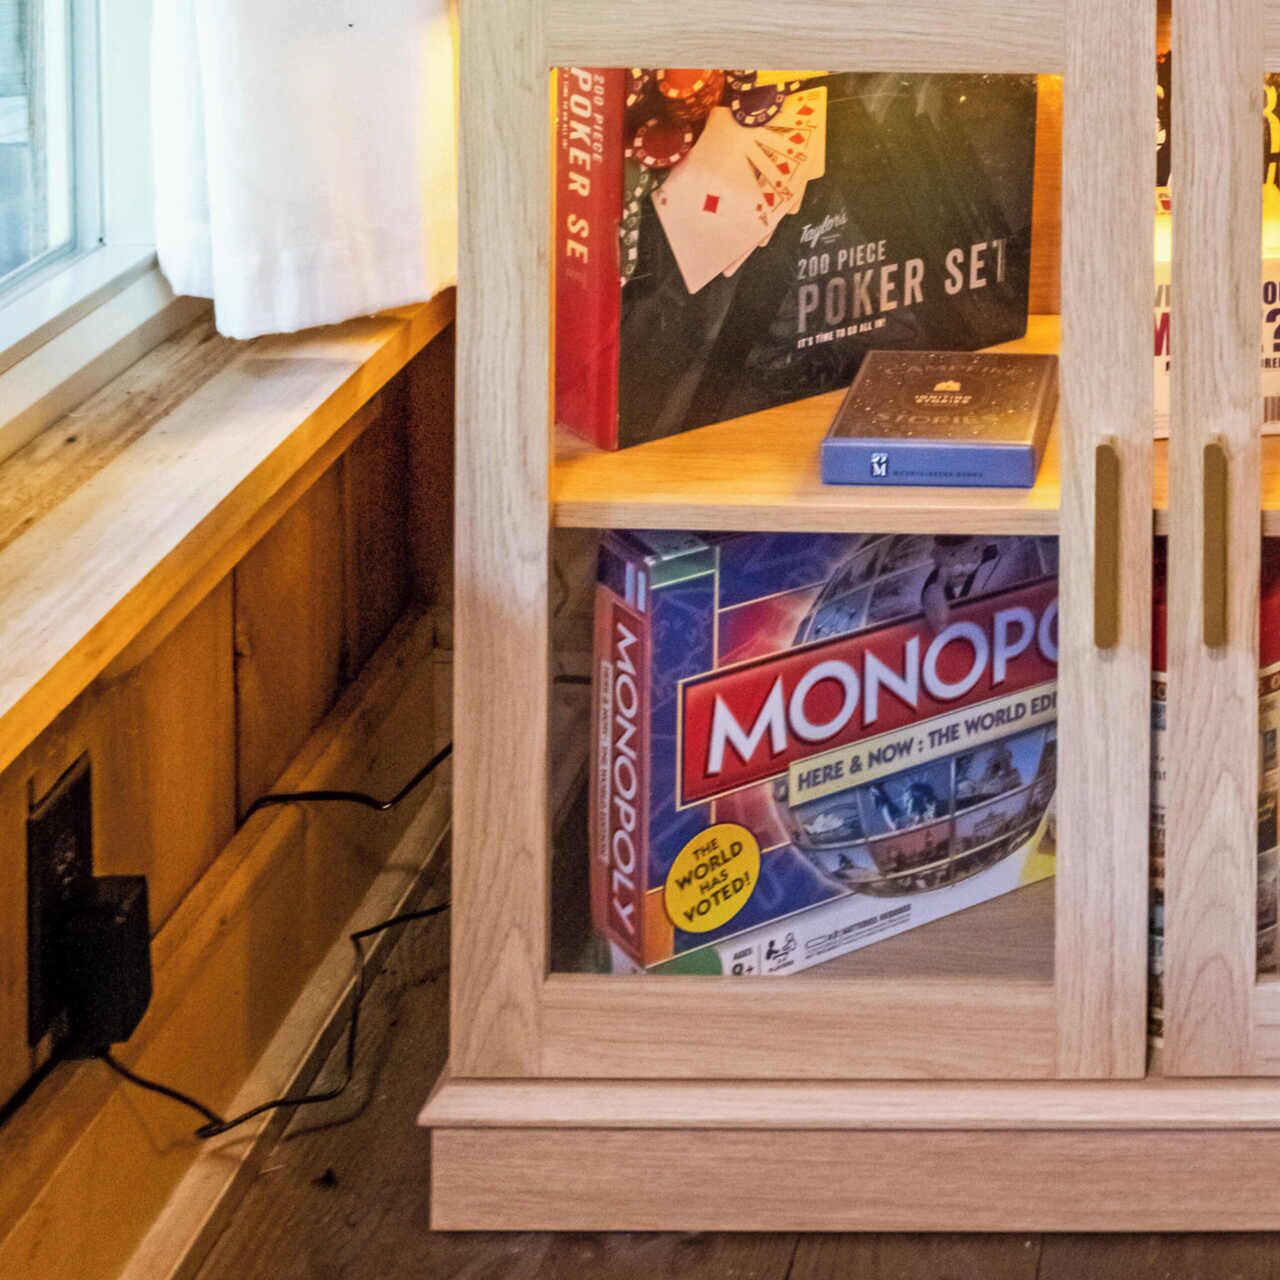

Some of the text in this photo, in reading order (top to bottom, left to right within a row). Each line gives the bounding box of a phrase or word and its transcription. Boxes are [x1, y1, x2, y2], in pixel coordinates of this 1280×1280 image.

[568, 67, 593, 197] POKER
[592, 112, 604, 163] PIECE
[797, 240, 887, 280] 200 PIECE
[797, 238, 1008, 334] POKER SET
[797, 760, 844, 792] HERE
[849, 754, 863, 773] &
[868, 738, 915, 769] NOW
[928, 723, 961, 750] THE
[964, 702, 1026, 736] WORLD
[612, 621, 639, 935] MONOPOLY
[674, 841, 744, 890] WORLD
[692, 838, 719, 860] THE
[683, 870, 751, 923] VOTED!
[699, 868, 729, 895] HAS
